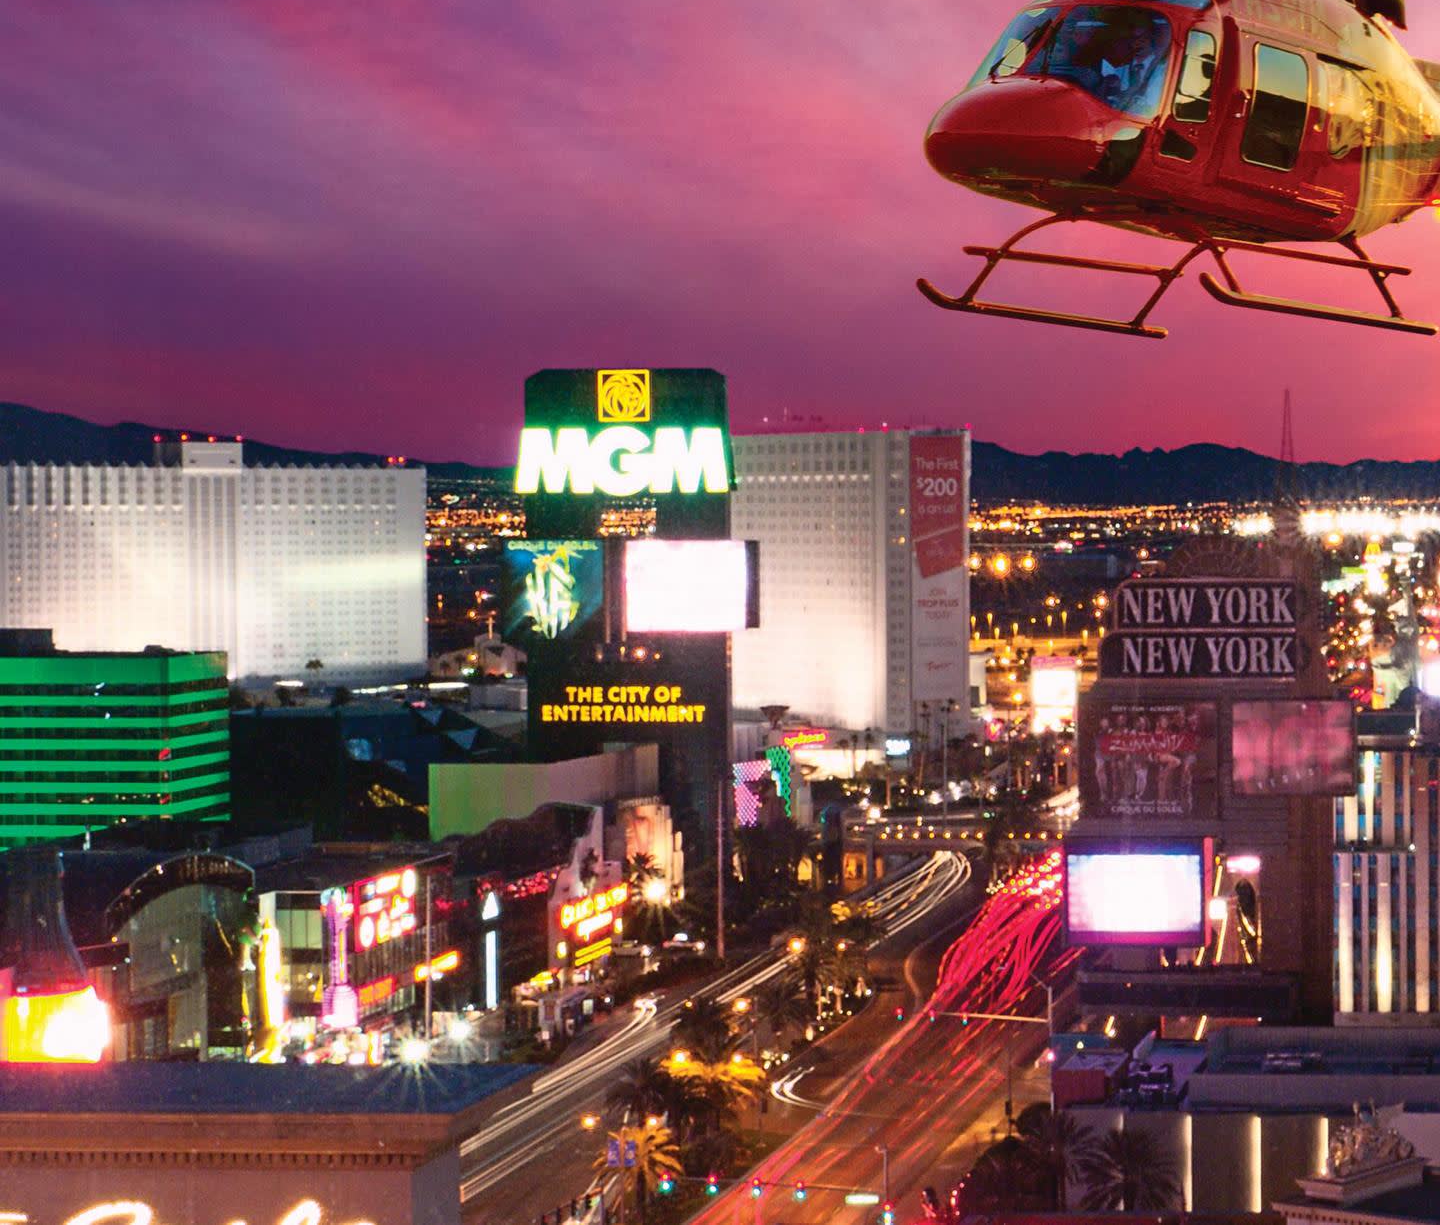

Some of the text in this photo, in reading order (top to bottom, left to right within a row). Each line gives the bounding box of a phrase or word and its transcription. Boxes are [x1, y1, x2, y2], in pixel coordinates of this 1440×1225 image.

[515, 425, 729, 496] MGM
[915, 457, 960, 471] The First
[916, 477, 958, 496] $200
[1122, 587, 1295, 624] NEW YORK
[1122, 637, 1295, 674] NEW YORK
[565, 686, 682, 704] THE CITY OF
[541, 705, 706, 723] ENTERTAINMENT
[1109, 734, 1185, 752] ZUMANITY
